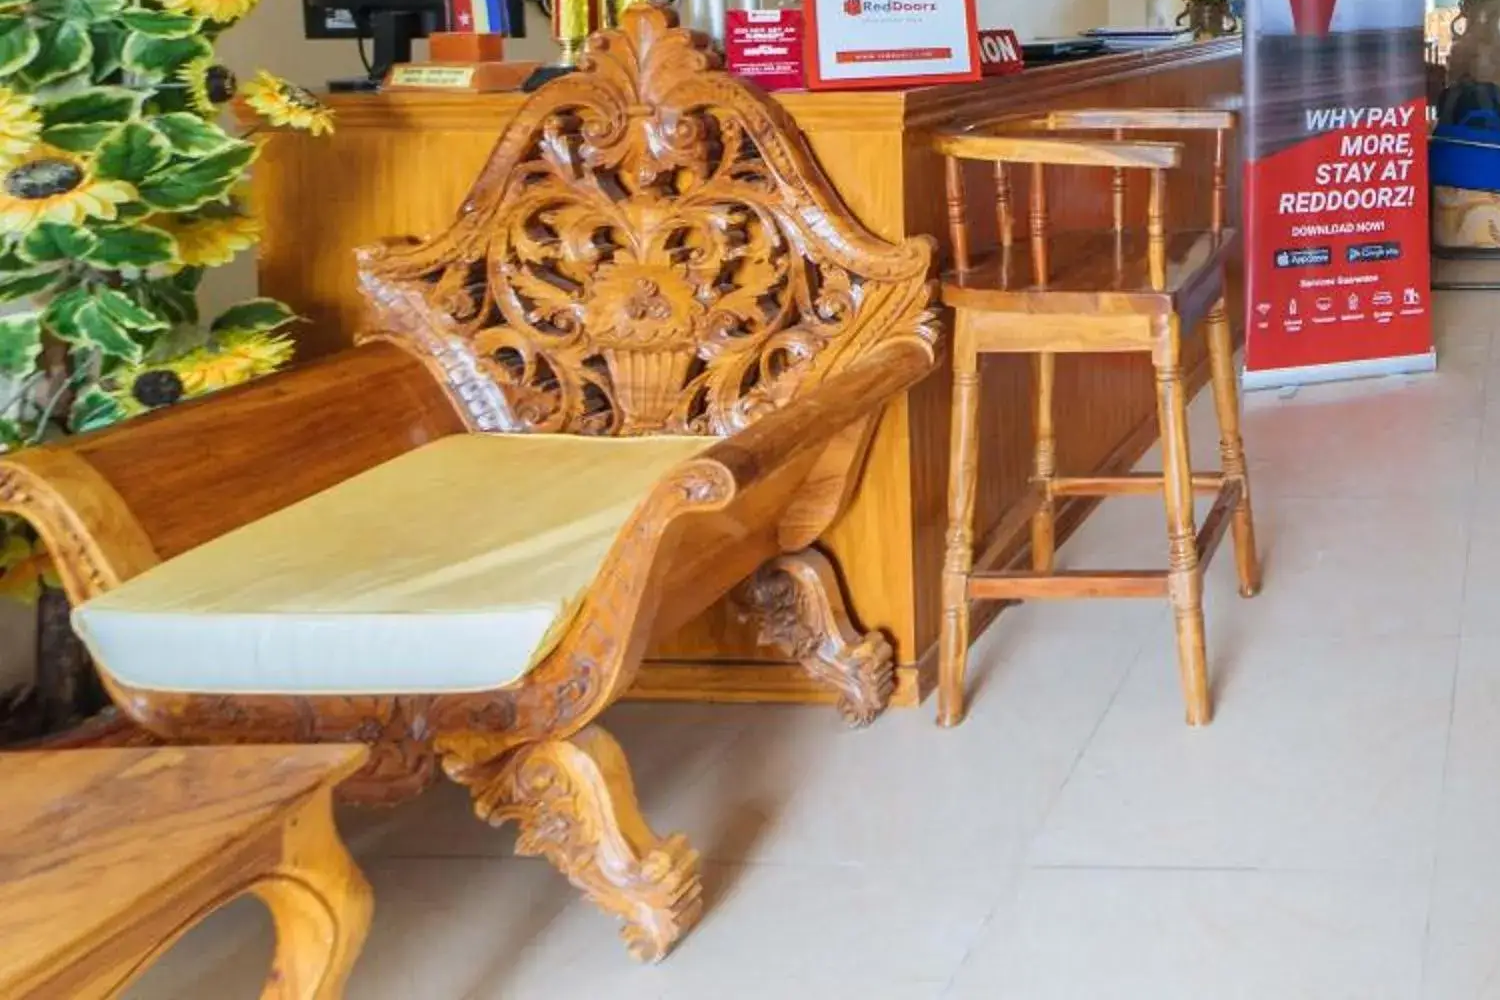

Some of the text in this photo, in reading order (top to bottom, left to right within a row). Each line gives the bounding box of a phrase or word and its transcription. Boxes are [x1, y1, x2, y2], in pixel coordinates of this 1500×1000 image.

[1305, 105, 1415, 131] WHY PAY
[1340, 133, 1414, 157] MORE,
[1315, 159, 1414, 185] STAY AT
[1279, 186, 1415, 214] REDDOORZ!
[1291, 221, 1385, 237] DOWNLOAD NOW!
